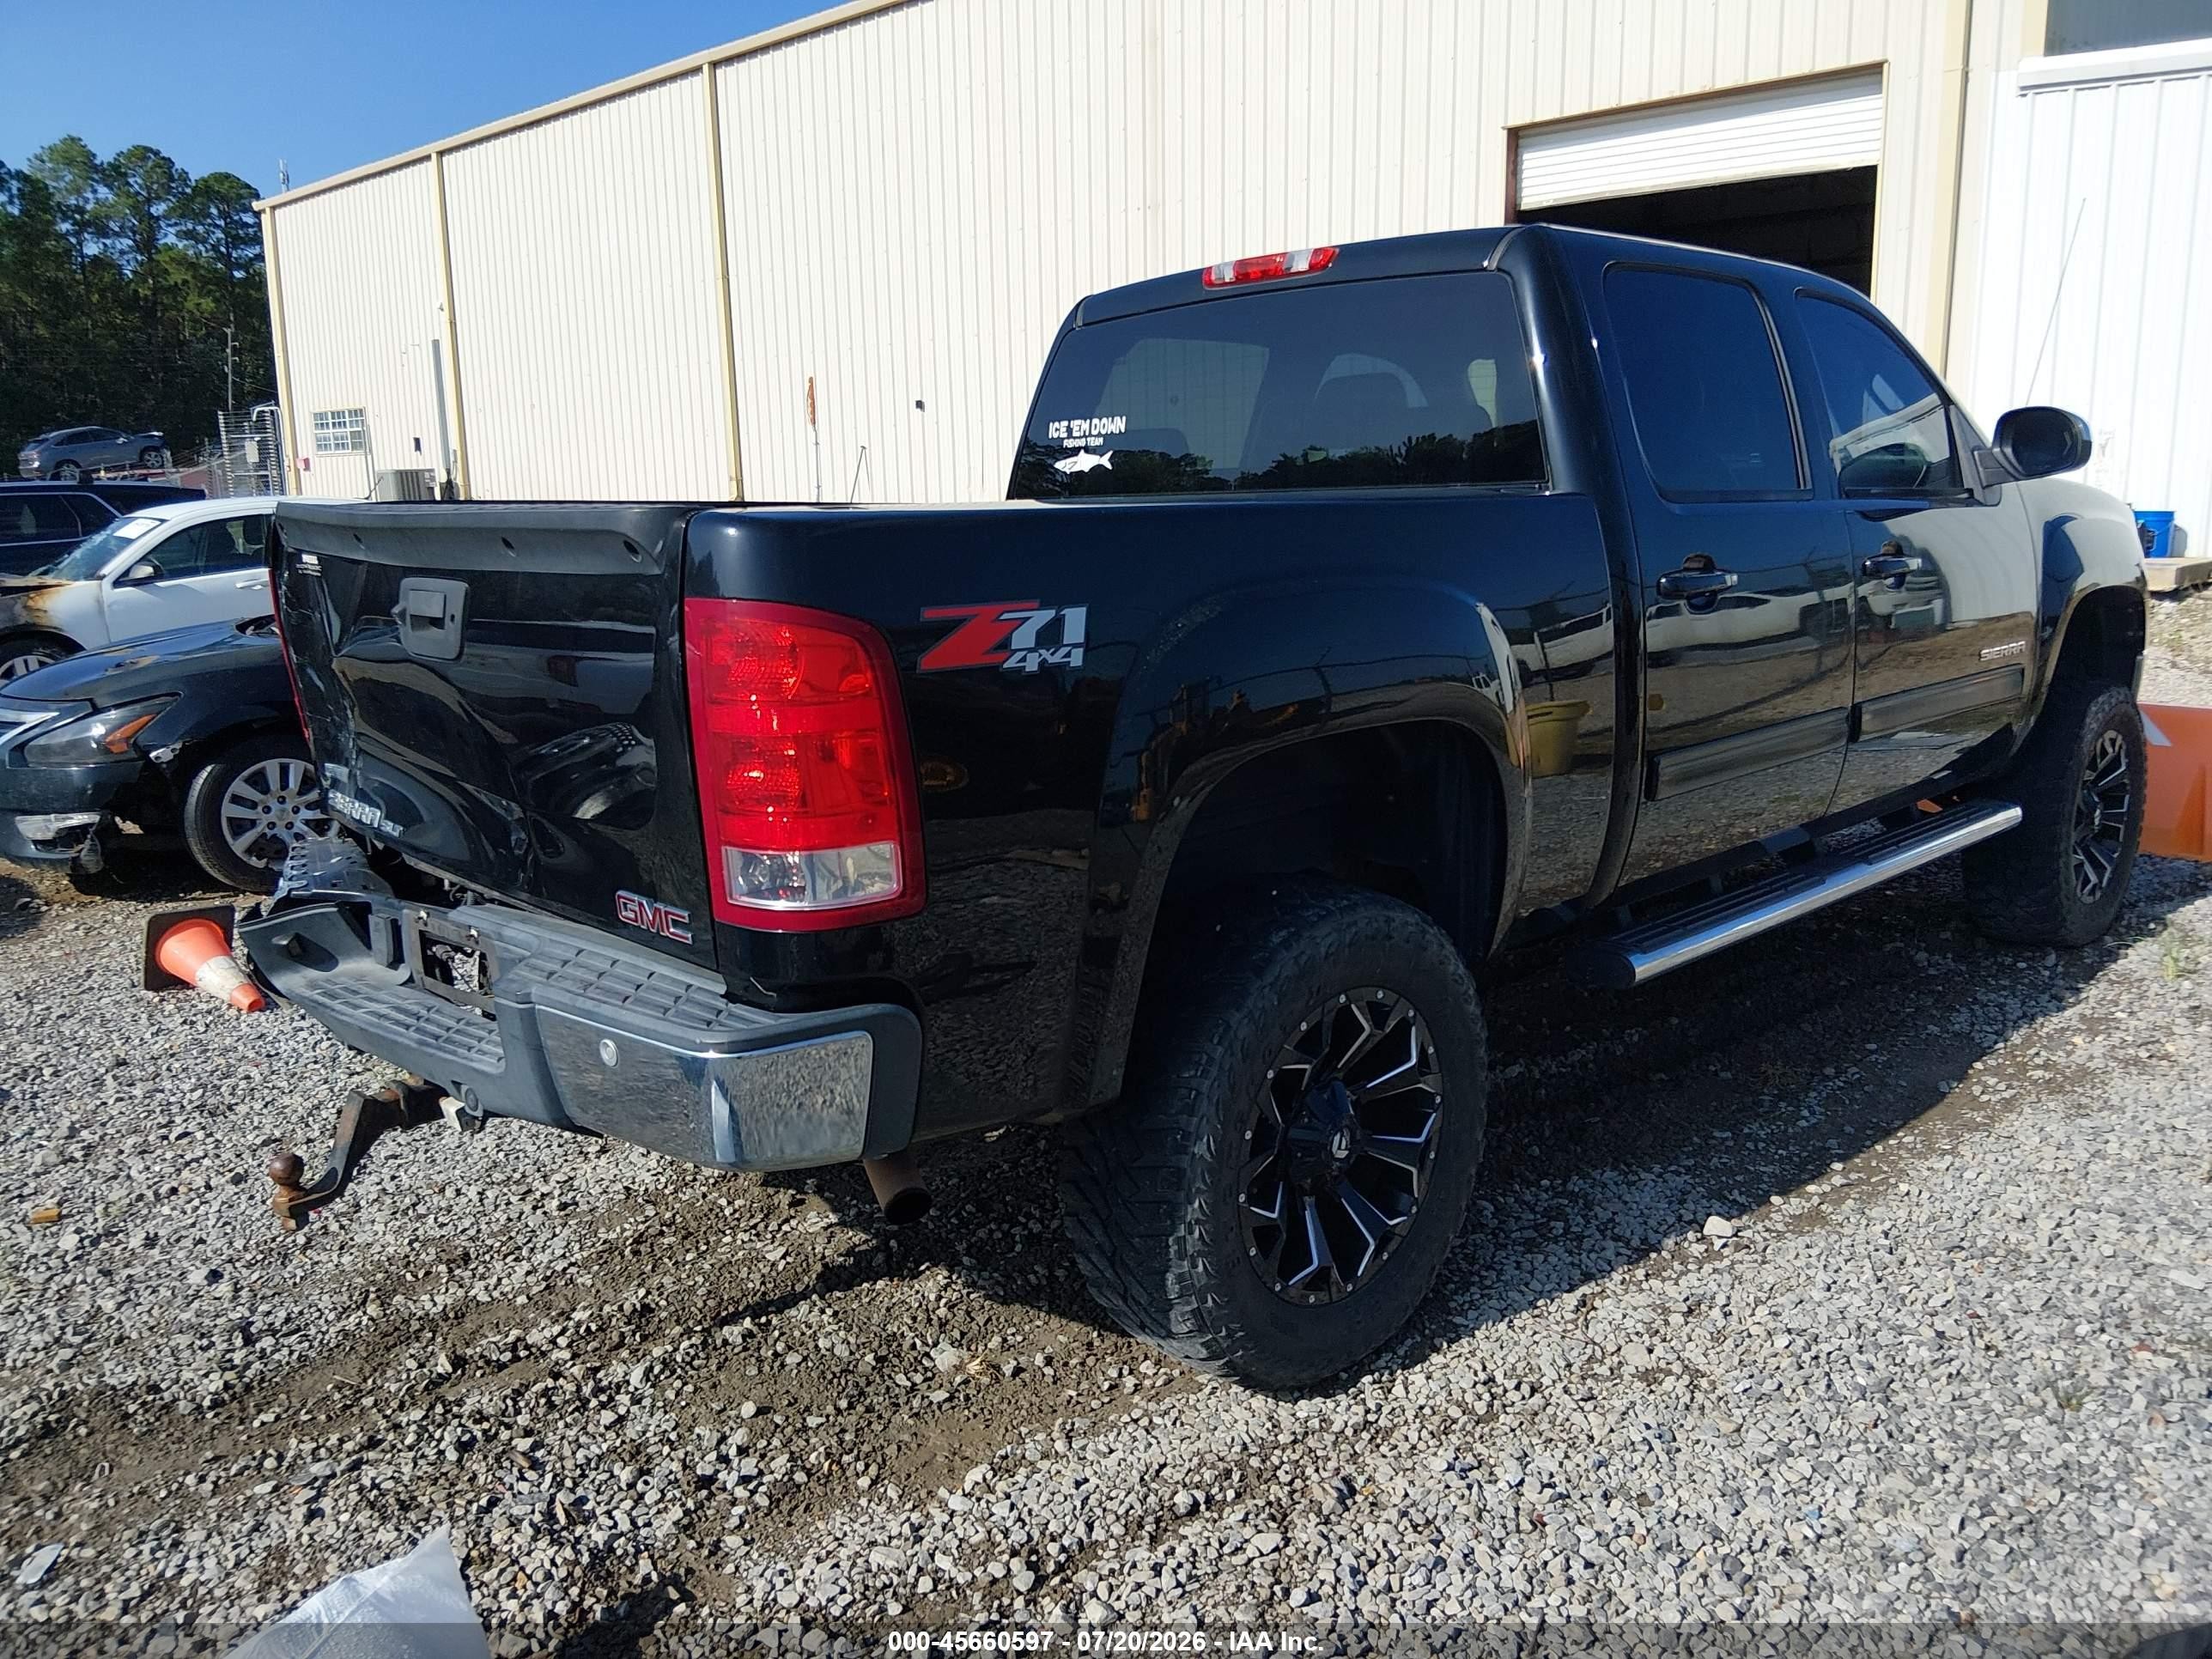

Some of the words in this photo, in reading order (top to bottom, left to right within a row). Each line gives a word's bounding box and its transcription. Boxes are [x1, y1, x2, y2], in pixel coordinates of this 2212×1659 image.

[1048, 420, 1069, 439] ICE
[1091, 416, 1127, 435] DOWN
[1086, 436, 1103, 447] TEAM
[917, 600, 1088, 672] Z71
[1979, 641, 2027, 661] SIERRA
[616, 890, 693, 945] GMC
